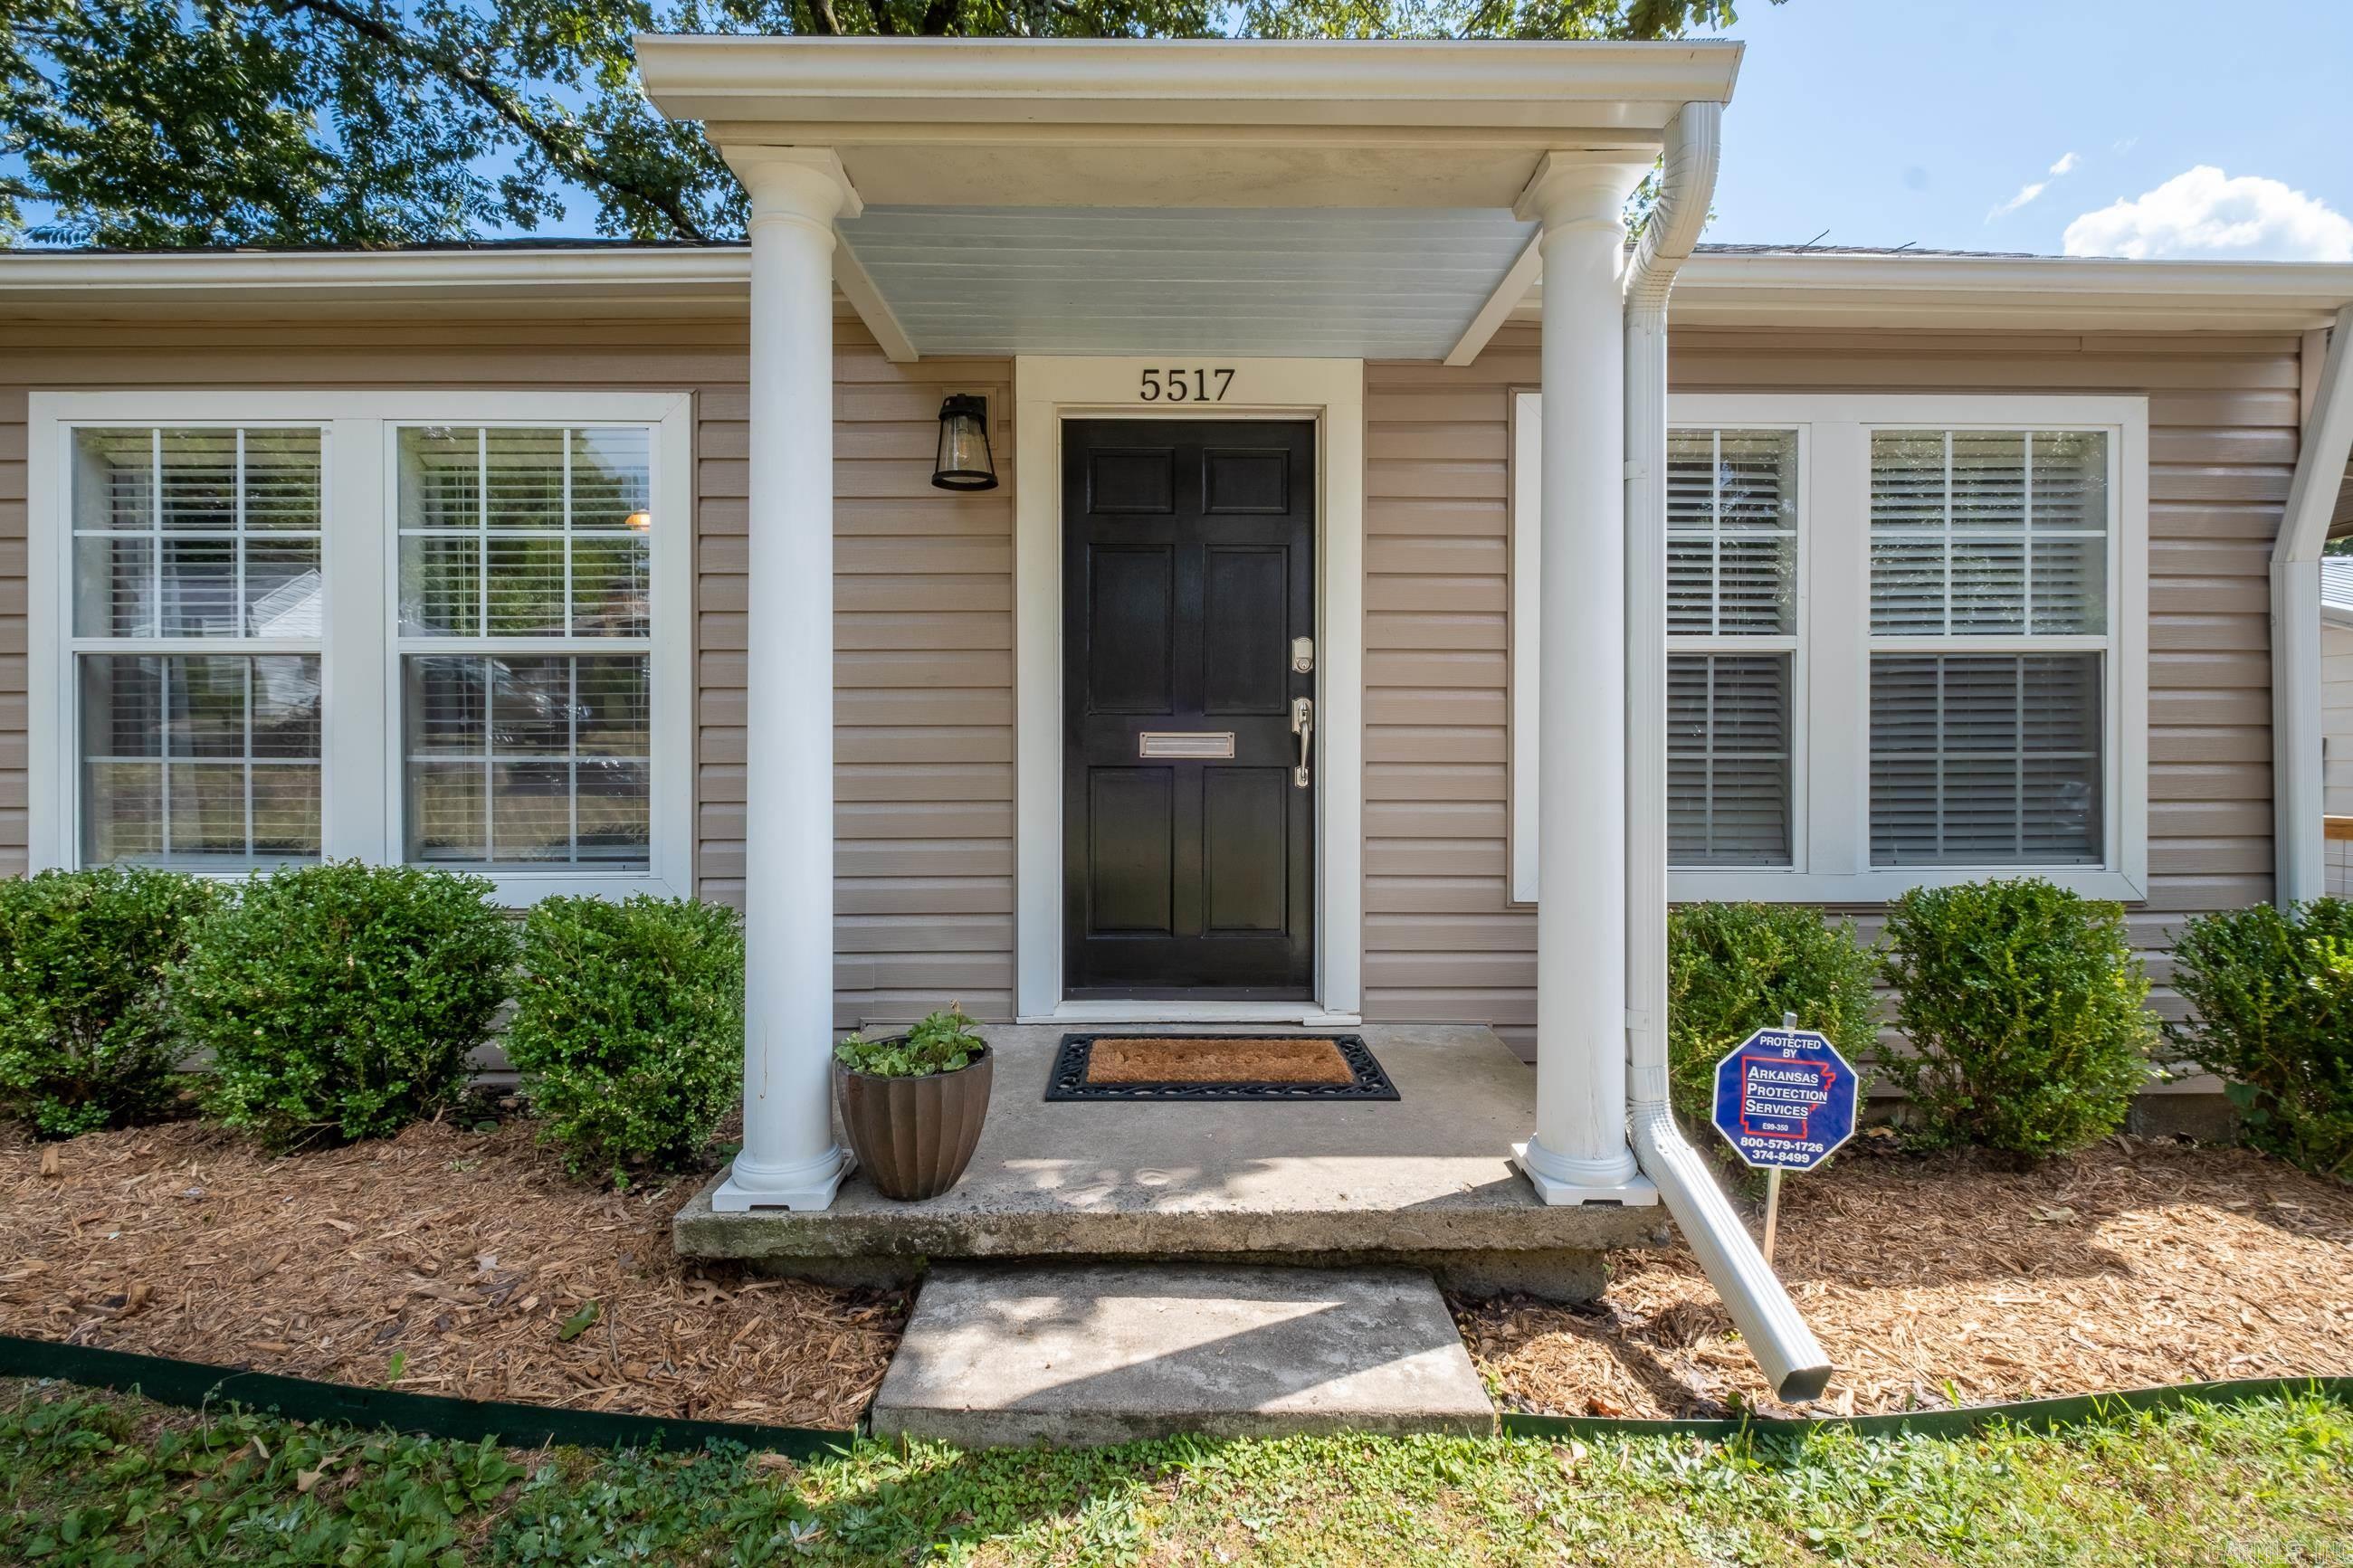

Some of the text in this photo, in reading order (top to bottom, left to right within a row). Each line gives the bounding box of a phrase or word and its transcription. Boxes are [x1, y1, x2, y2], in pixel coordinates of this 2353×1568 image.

[1140, 369, 1235, 401] 5517
[1760, 1036, 1822, 1050] PROTECTED
[1783, 1049, 1797, 1058] BY
[1748, 1066, 1819, 1083] ARKANSAS
[1747, 1083, 1828, 1101] PROTECTION
[1745, 1099, 1809, 1117] SERVICES
[1740, 1136, 1824, 1153] 800-579-1726
[1752, 1150, 1810, 1164] 374-8499
